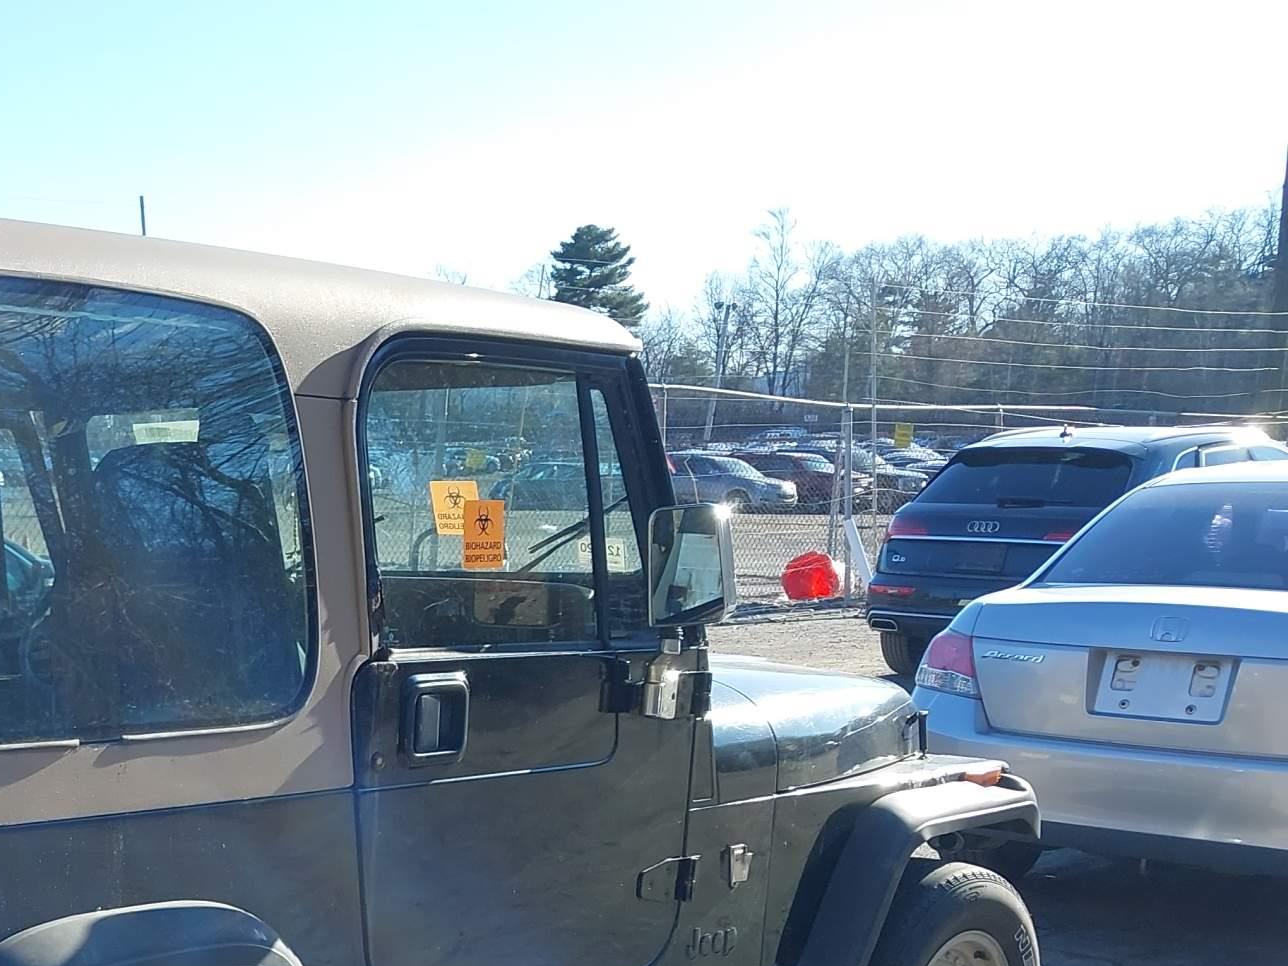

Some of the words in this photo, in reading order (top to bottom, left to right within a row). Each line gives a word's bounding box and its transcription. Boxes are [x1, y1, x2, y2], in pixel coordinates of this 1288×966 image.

[465, 541, 502, 550] BIOHAZARD
[465, 553, 502, 562] BIOPELIGRO
[983, 650, 1045, 663] Accord
[685, 926, 738, 960] Jeep
